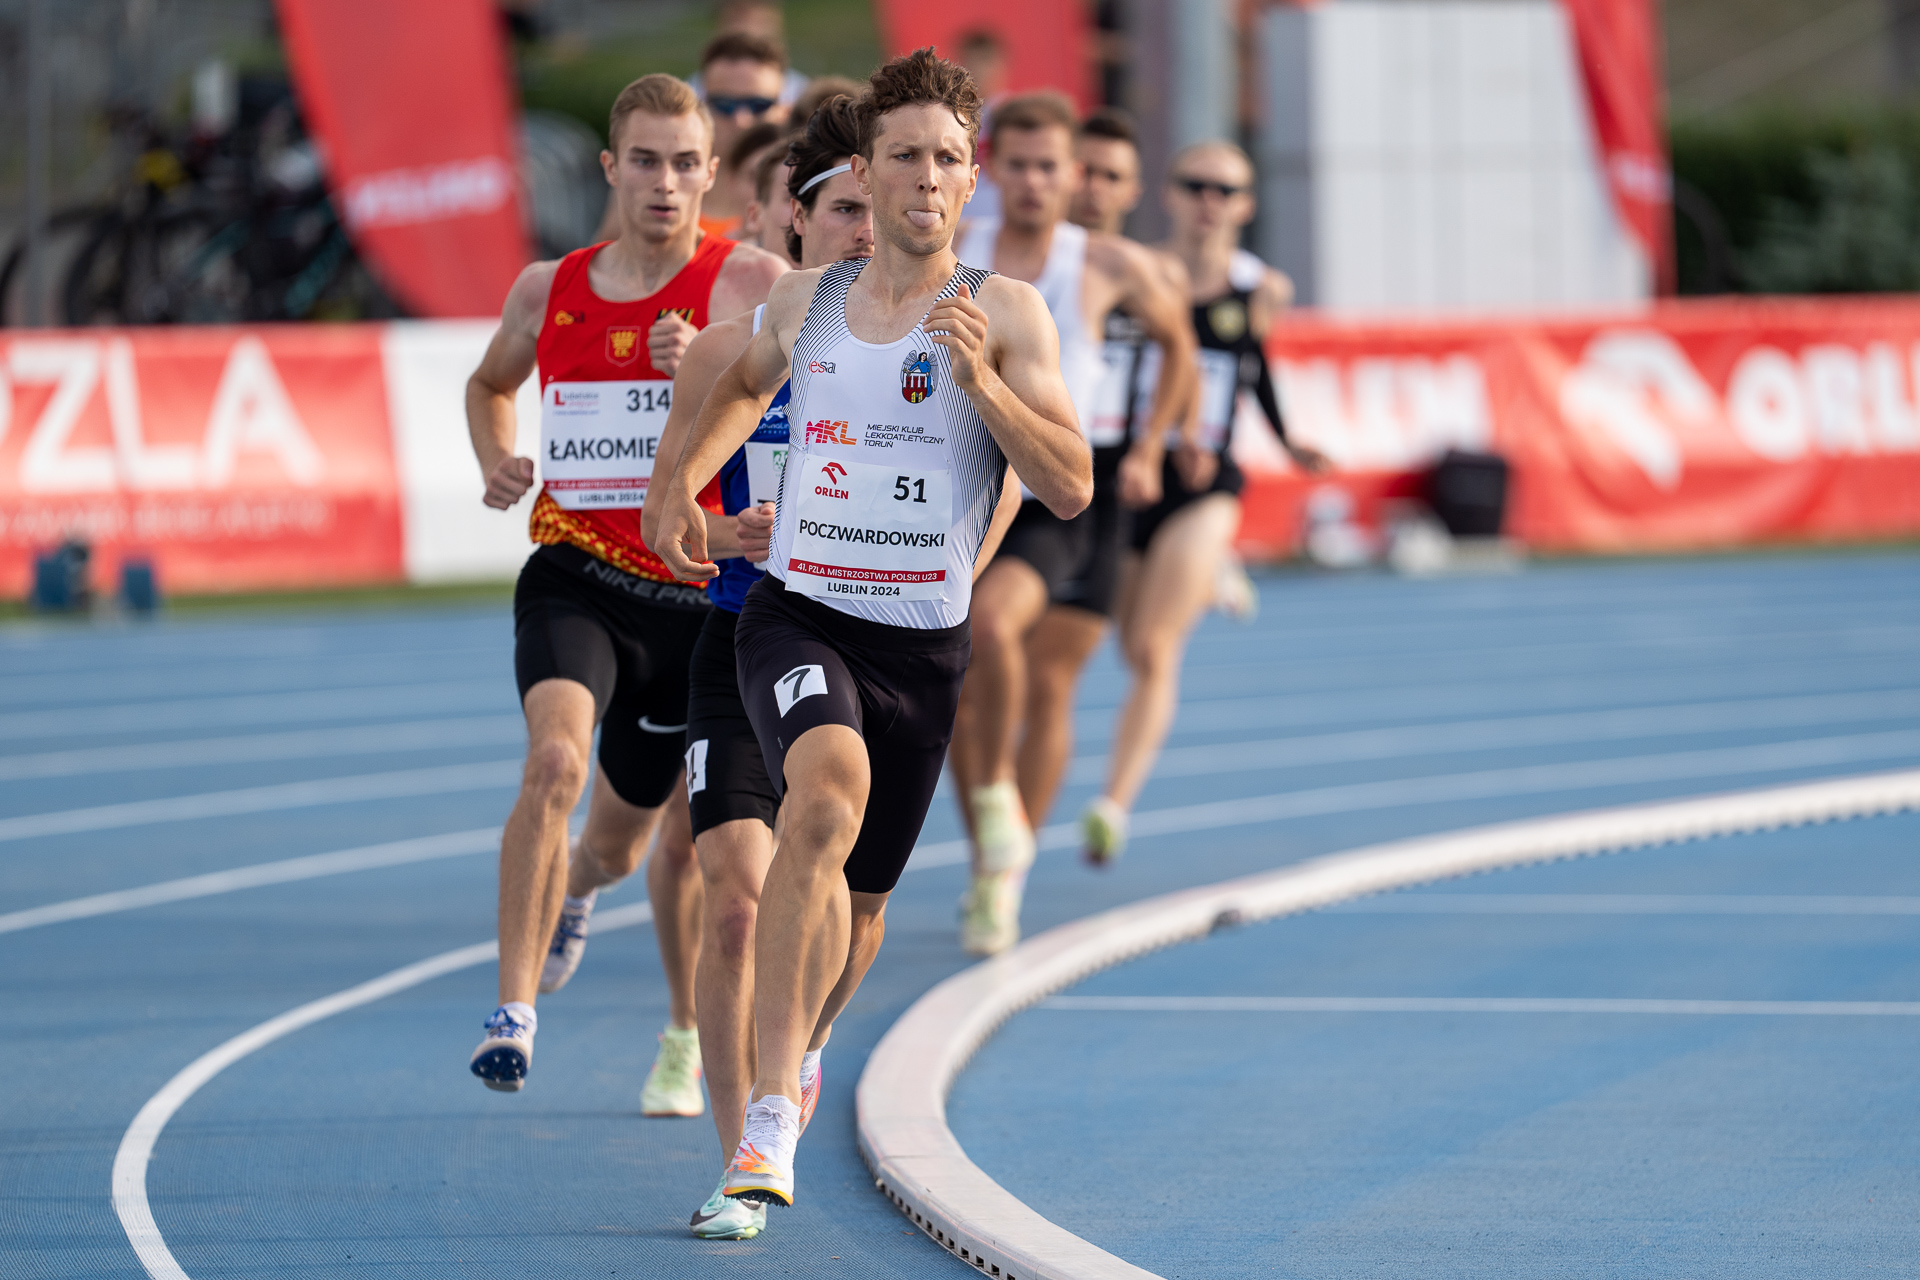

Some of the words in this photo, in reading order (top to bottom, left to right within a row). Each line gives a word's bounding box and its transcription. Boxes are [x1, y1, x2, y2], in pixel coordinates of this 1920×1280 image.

[808, 360, 837, 375] esa
[626, 386, 671, 412] 314
[1726, 342, 1920, 458] ORL
[0, 333, 325, 492] ZLA
[805, 419, 858, 446] MKL
[865, 431, 945, 445] LEKKOATLETYCZNY
[866, 423, 899, 433] MIEJSKI
[900, 425, 924, 435] KLUB
[548, 436, 658, 461] ŁAKOMIE
[863, 439, 894, 449] TORUŃ
[578, 492, 616, 504] LUBLIN
[814, 485, 849, 500] ORLEN
[893, 475, 927, 503] 51
[799, 519, 945, 548] POCZWARDOWSKI
[583, 558, 659, 599] NIKE
[797, 562, 807, 572] 41.
[808, 564, 825, 575] PZLA
[827, 567, 889, 581] MISTRZOSTWA
[891, 573, 920, 582] POLSKI
[921, 572, 938, 581] U23
[827, 582, 868, 595] LUBLIN
[870, 585, 900, 597] 2024
[782, 667, 811, 702] 7
